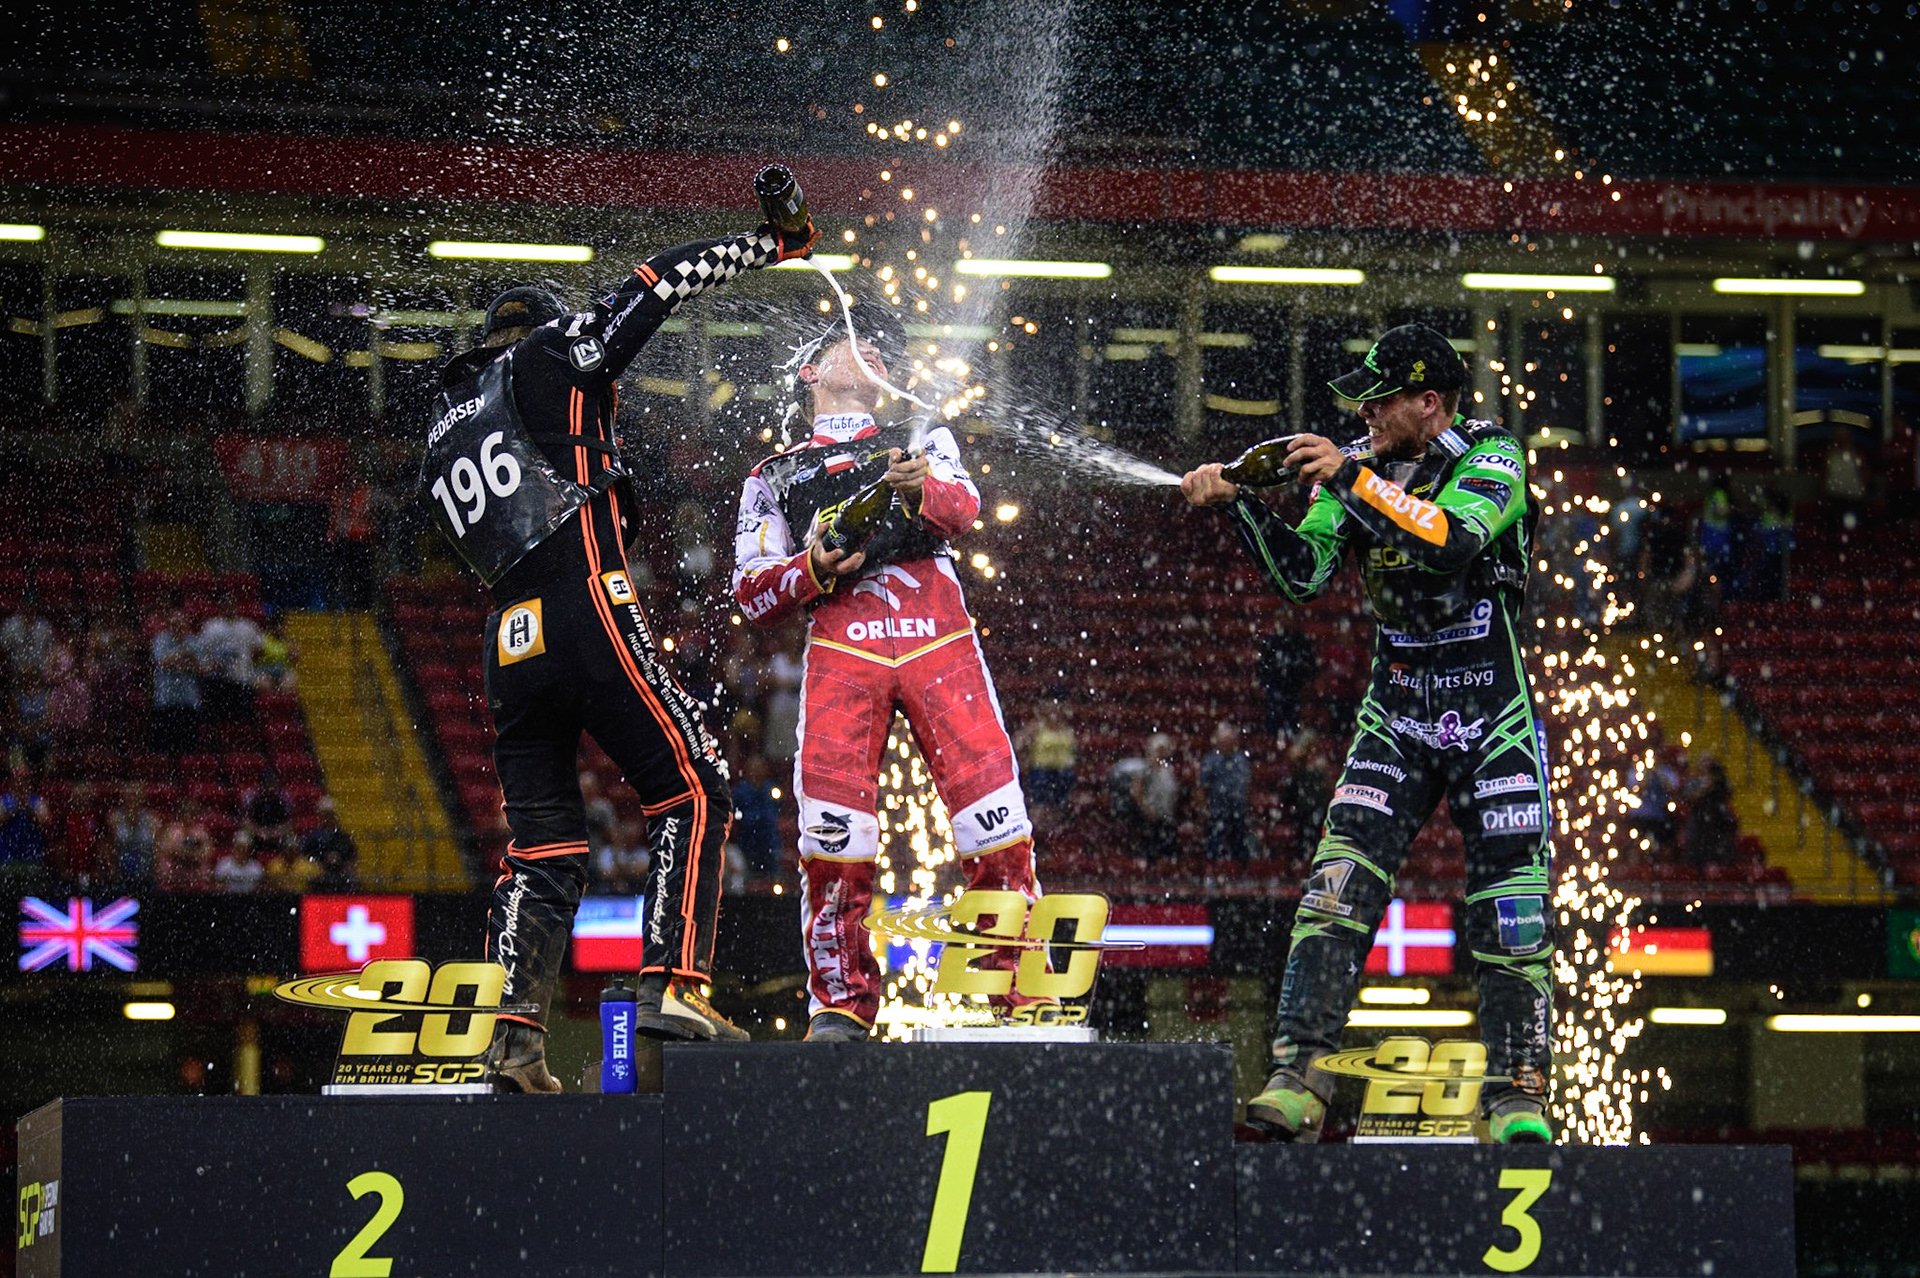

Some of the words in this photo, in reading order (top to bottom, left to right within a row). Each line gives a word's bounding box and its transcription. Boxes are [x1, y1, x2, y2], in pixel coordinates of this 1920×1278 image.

[1662, 187, 1870, 238] Principality
[428, 394, 486, 449] PEDERSEN
[431, 431, 522, 539] 196
[627, 604, 655, 651] HARRY
[847, 618, 936, 641] ORLEN
[1464, 670, 1494, 687] Byg
[1482, 803, 1541, 831] Orloff
[934, 890, 1110, 998] 20
[341, 959, 506, 1057] 20
[1009, 1005, 1088, 1026] SGP
[613, 1011, 628, 1059] ELTAL
[335, 1075, 356, 1084] FIM
[360, 1075, 407, 1084] BRITISH
[338, 1064, 353, 1073] 20
[356, 1064, 393, 1073] YEARS
[395, 1064, 411, 1073] OF
[411, 1063, 485, 1084] SGP
[1363, 1040, 1489, 1116] 20
[1416, 1120, 1472, 1137] SGP
[920, 1091, 992, 1273] 1
[329, 1170, 404, 1278] 2
[1482, 1169, 1553, 1273] 3
